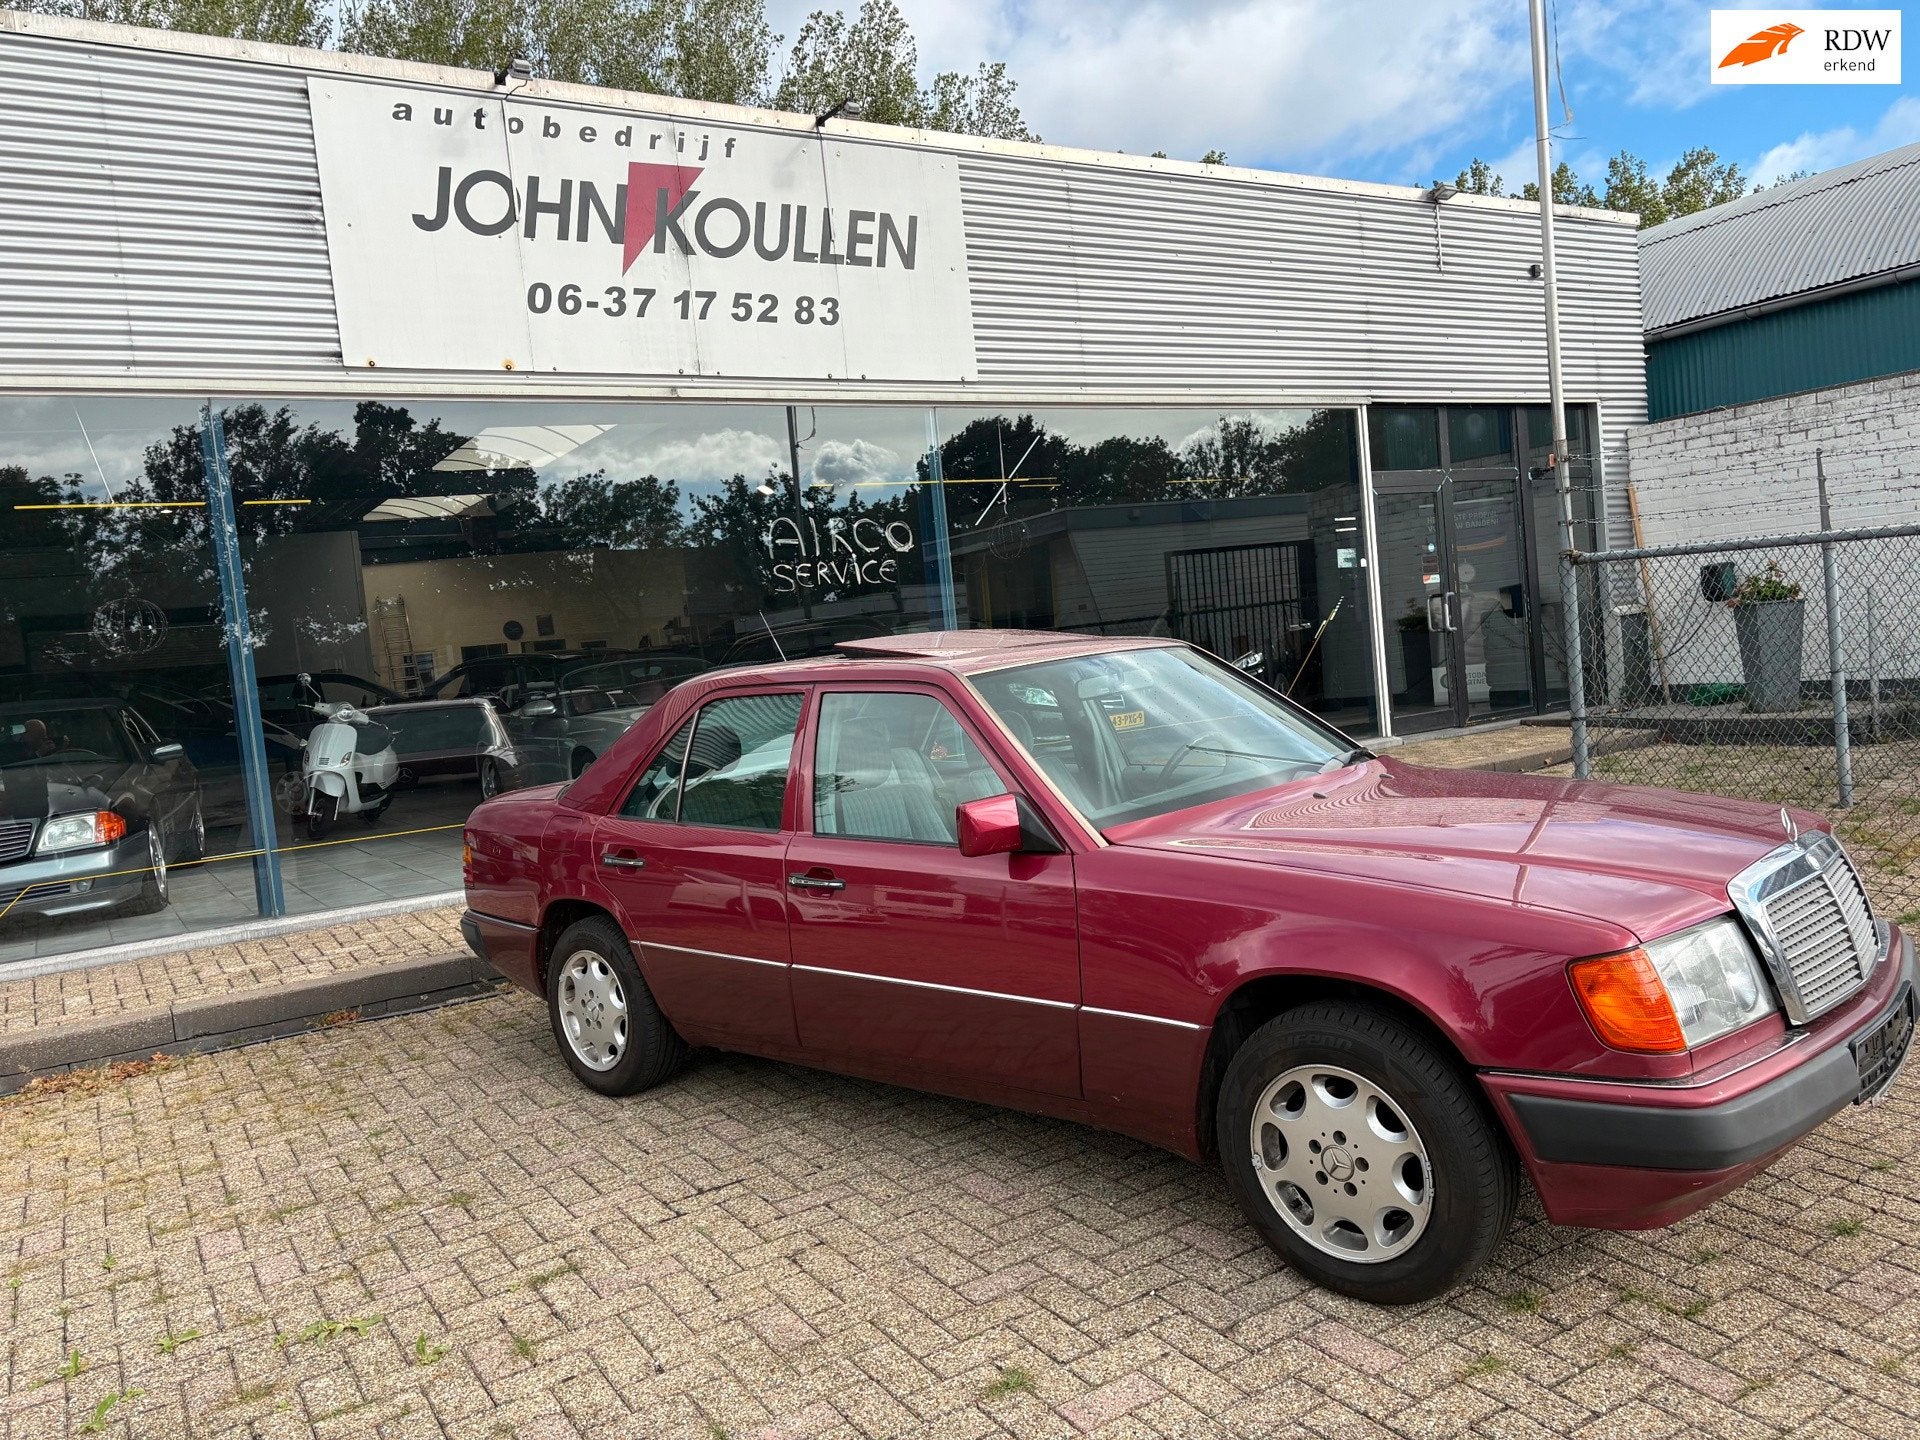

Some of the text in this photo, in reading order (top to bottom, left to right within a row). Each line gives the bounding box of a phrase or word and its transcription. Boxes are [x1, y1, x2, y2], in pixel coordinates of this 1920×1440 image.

[391, 102, 740, 161] autobedrijf
[411, 166, 919, 271] JOHN KOULLEN
[526, 281, 841, 327] 06-37 17 52 83
[768, 516, 915, 560] AIRCO
[773, 555, 897, 592] SERVICE
